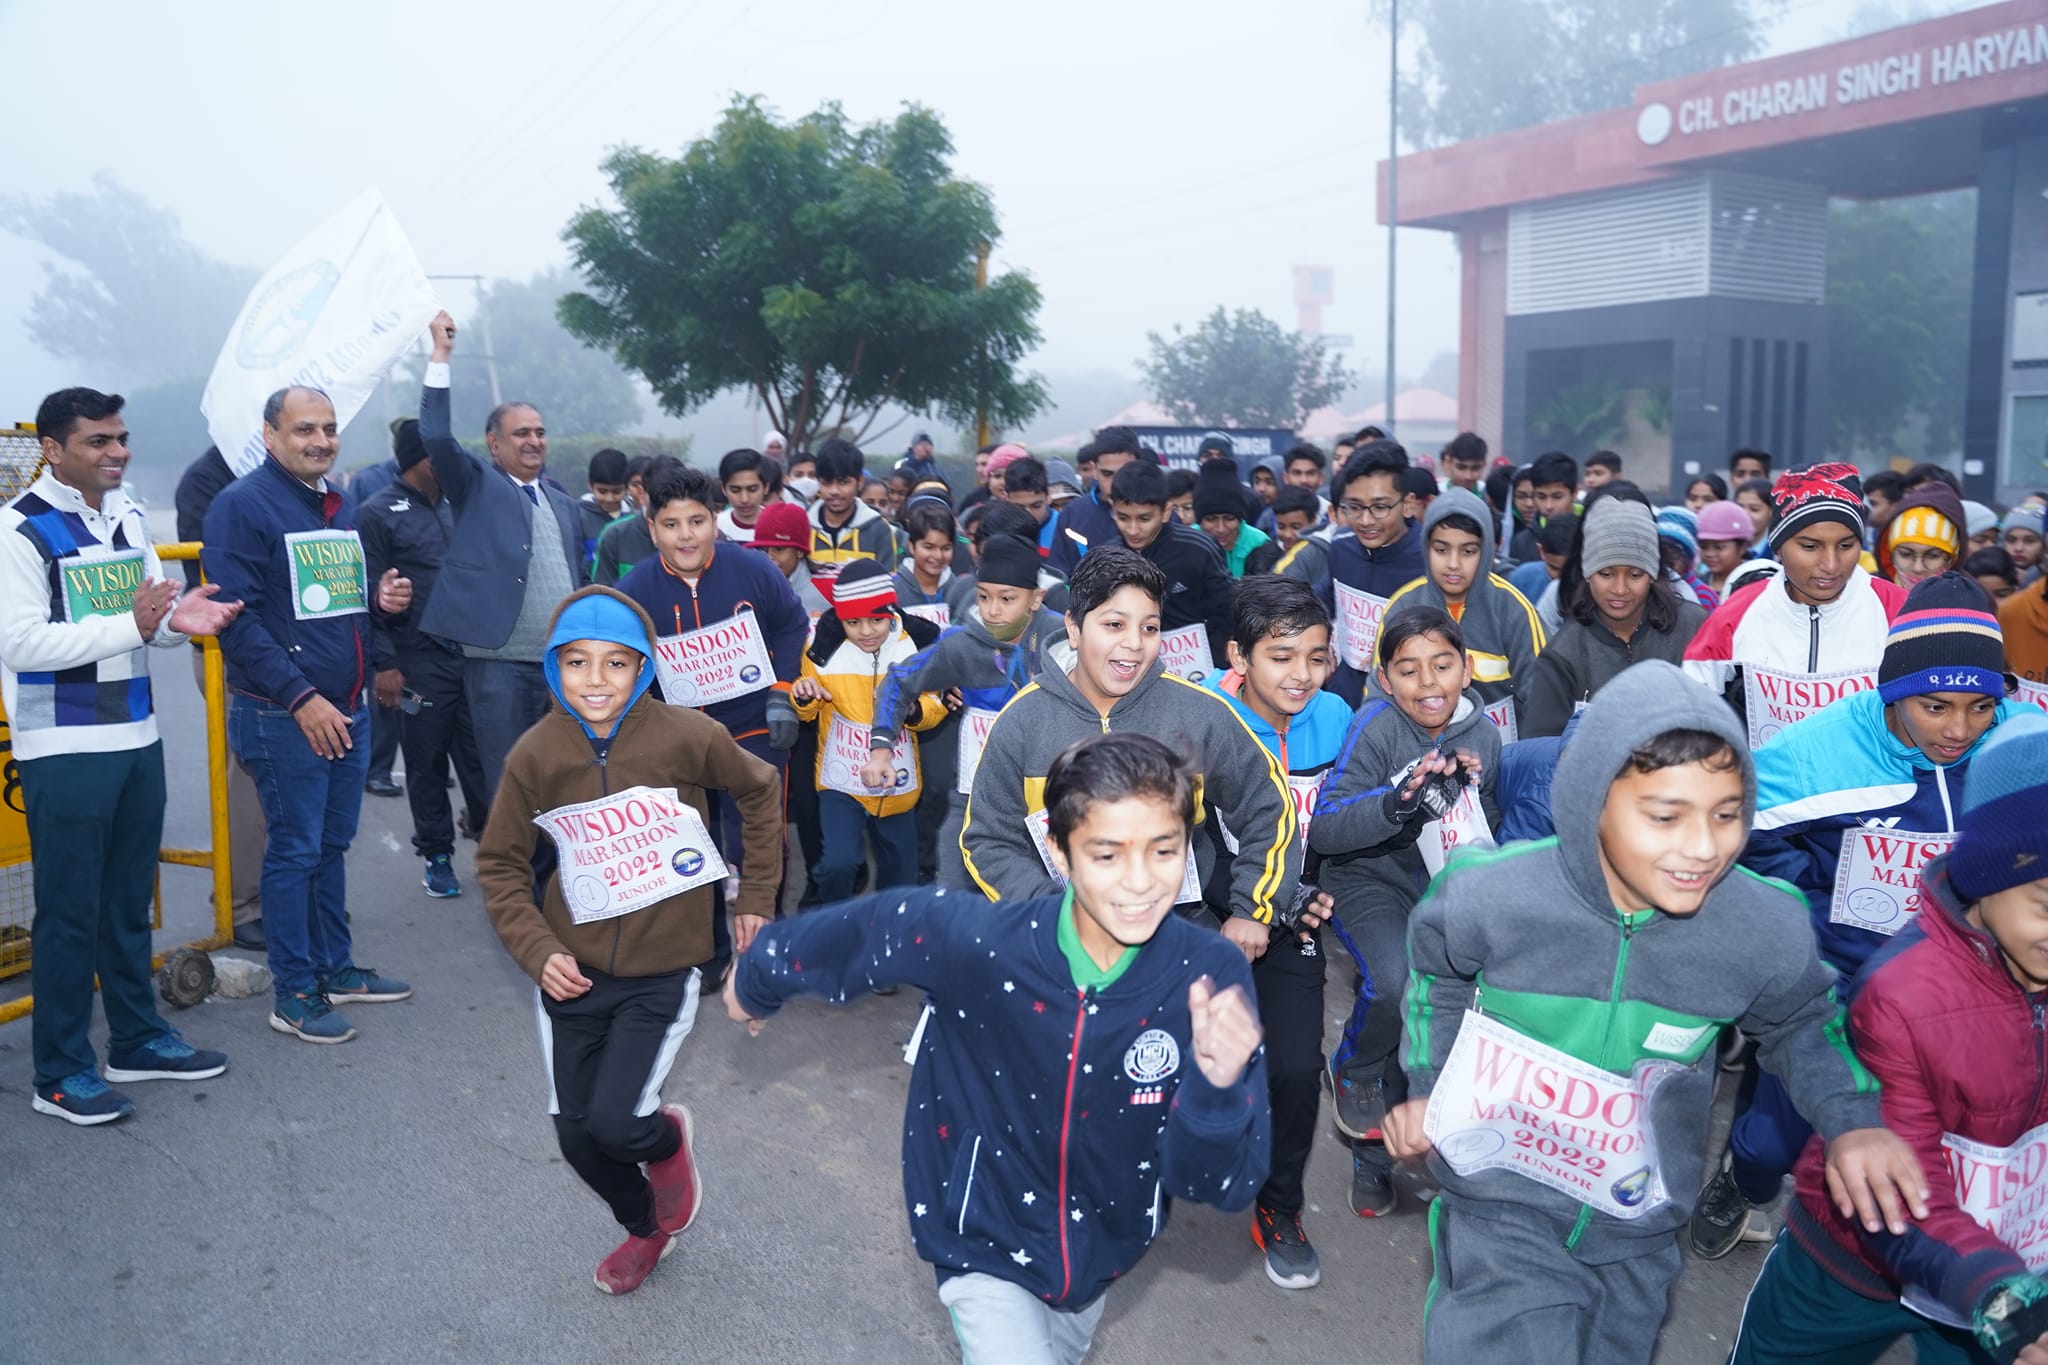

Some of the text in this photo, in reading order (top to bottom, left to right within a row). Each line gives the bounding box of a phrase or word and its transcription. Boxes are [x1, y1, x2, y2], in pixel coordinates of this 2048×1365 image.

[1678, 96, 1718, 135] CH.
[1722, 72, 1827, 126] CHARAN
[1836, 51, 1921, 104] SINGH
[328, 579, 358, 597] 2022
[656, 621, 750, 662] WISDOM
[671, 645, 747, 675] MARATHON
[1158, 631, 1200, 656] DOM
[695, 664, 735, 687] 2022
[702, 682, 736, 697] JUNIOR
[835, 721, 909, 749] WISM
[554, 794, 684, 845] WISDOM
[573, 822, 679, 867] MARATHON
[603, 850, 664, 887] 2022
[617, 876, 668, 902] JUNIOR
[1472, 1036, 1648, 1130] WISDO
[1511, 1151, 1593, 1192] JUNIOR
[1513, 1128, 1608, 1179] 2022
